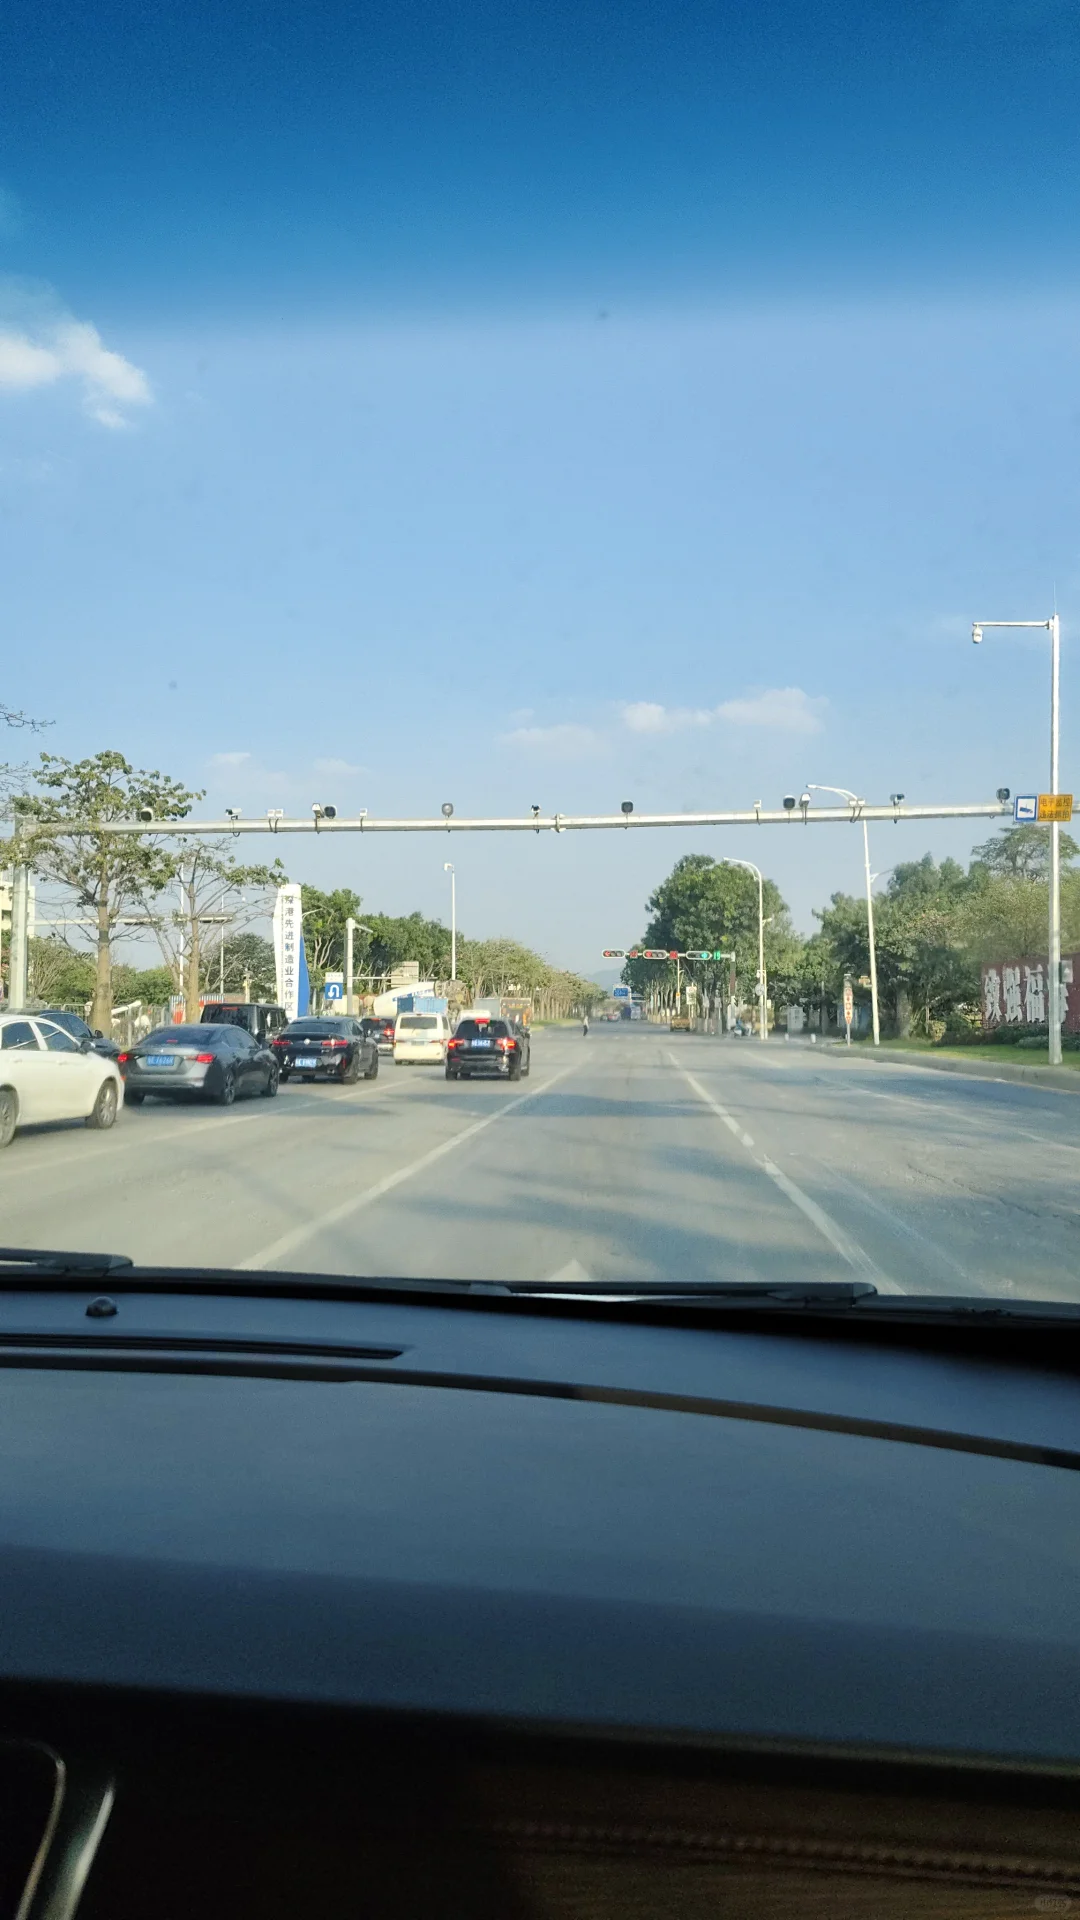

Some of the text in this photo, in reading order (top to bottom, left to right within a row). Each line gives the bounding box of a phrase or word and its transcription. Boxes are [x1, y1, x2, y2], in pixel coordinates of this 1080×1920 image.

[284, 895, 294, 1012] 深港先进制造业合作区
